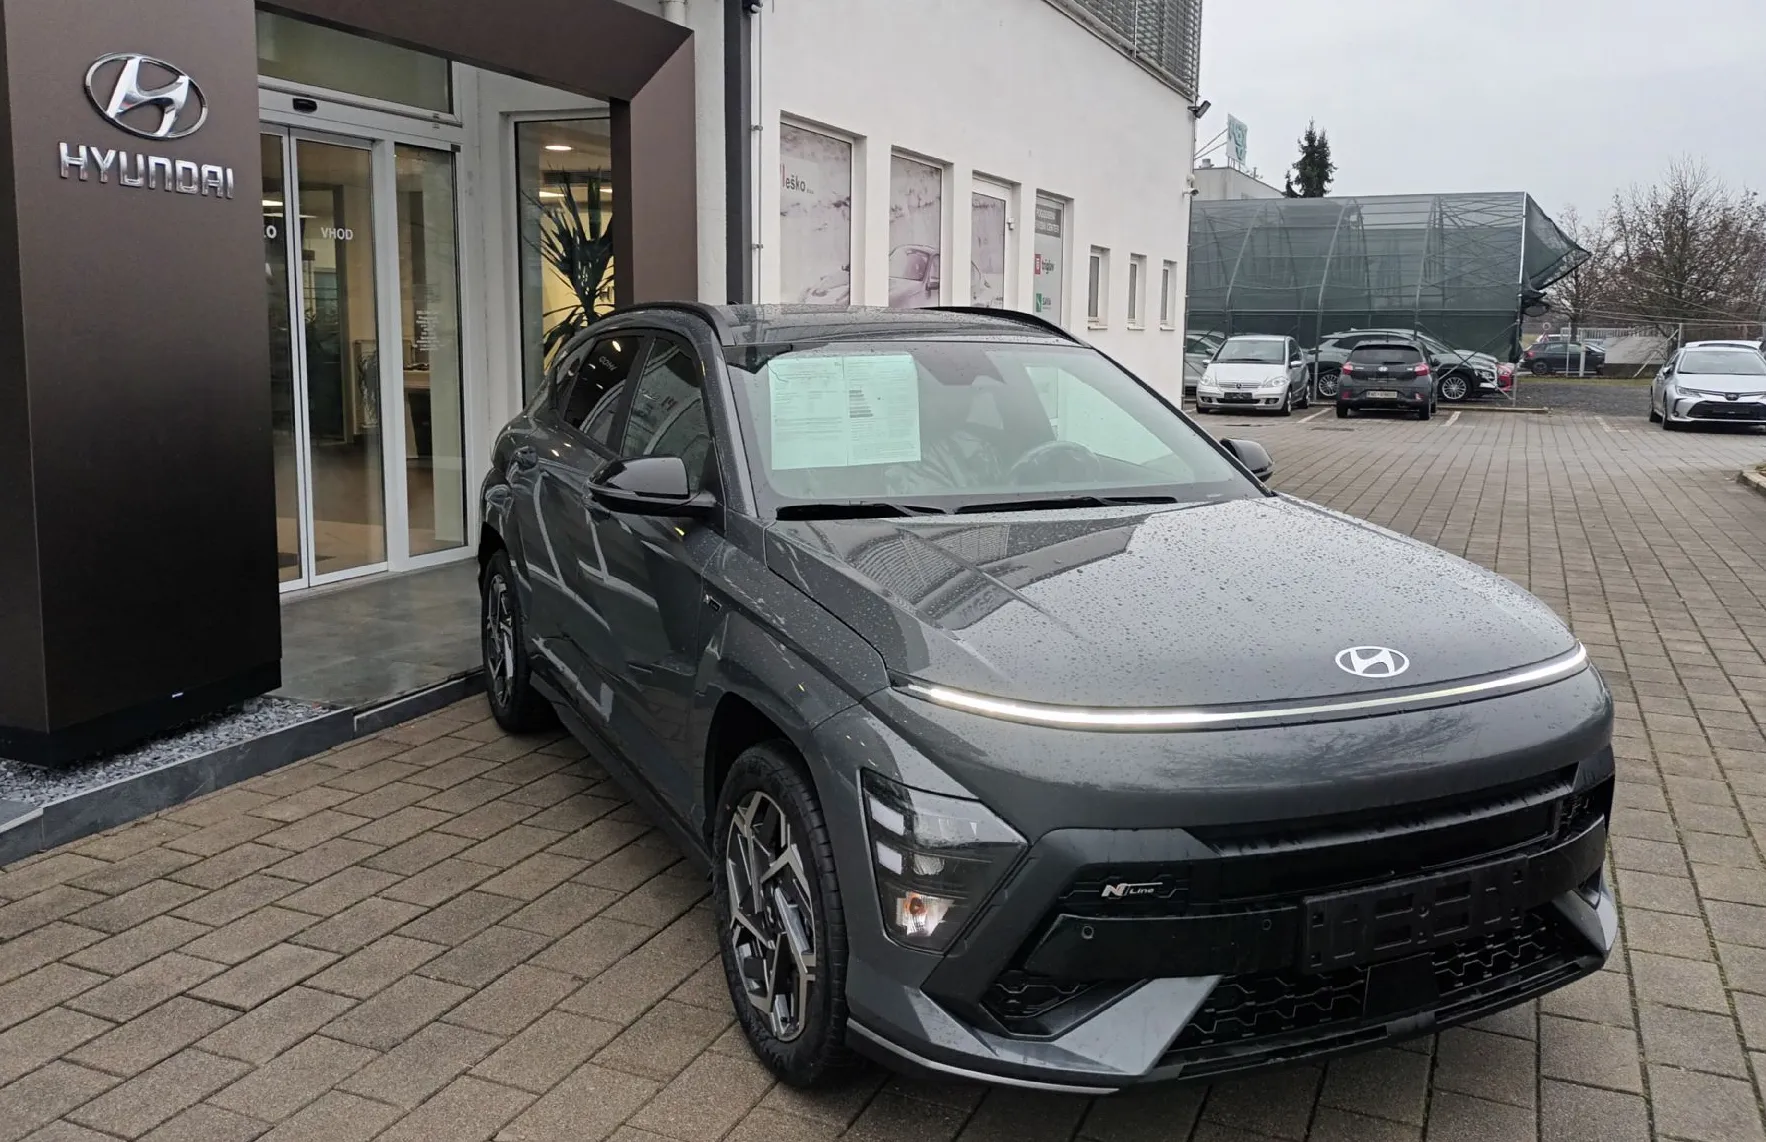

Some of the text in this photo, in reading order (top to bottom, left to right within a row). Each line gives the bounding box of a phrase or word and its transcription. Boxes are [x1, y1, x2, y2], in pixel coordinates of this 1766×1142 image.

[58, 142, 234, 200] HYUNDAI
[780, 163, 806, 192] leško
[321, 227, 354, 240] VHOD
